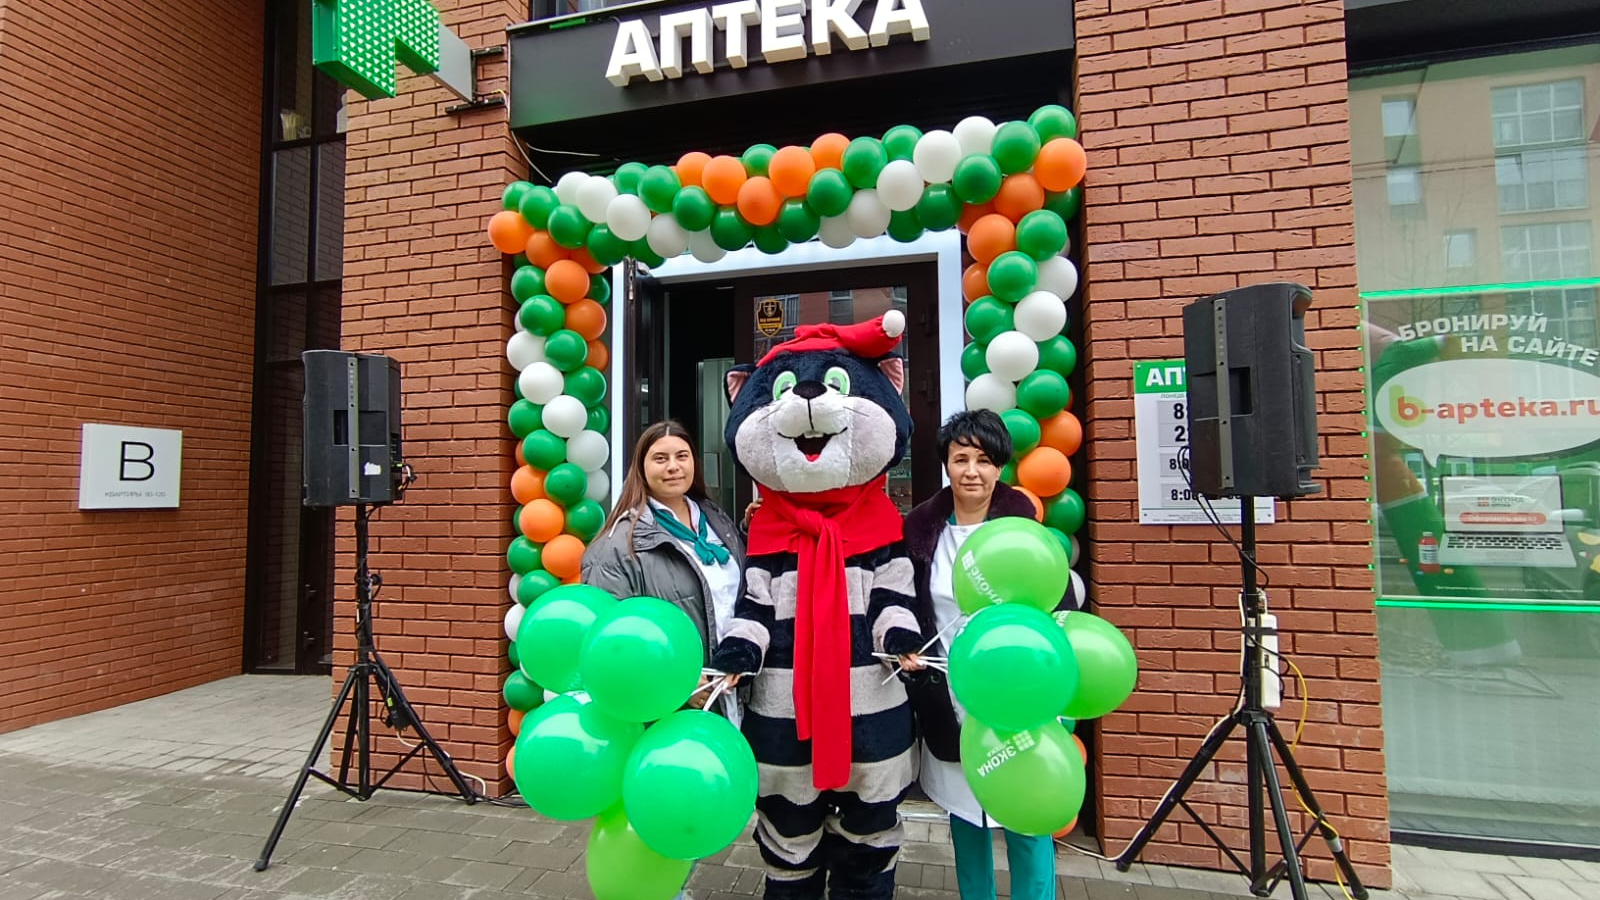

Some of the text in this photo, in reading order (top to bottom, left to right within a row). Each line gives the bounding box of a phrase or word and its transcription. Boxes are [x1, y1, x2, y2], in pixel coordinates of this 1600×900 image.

[605, 0, 930, 87] АПТЕКА
[1397, 312, 1548, 341] БРОНИРУЙ
[1460, 336, 1600, 367] НА САЙТЕ
[1146, 366, 1186, 387] АП
[1397, 396, 1600, 424] b-apteka.ru
[120, 441, 155, 481] В
[977, 745, 1017, 777] ЭКОНА
